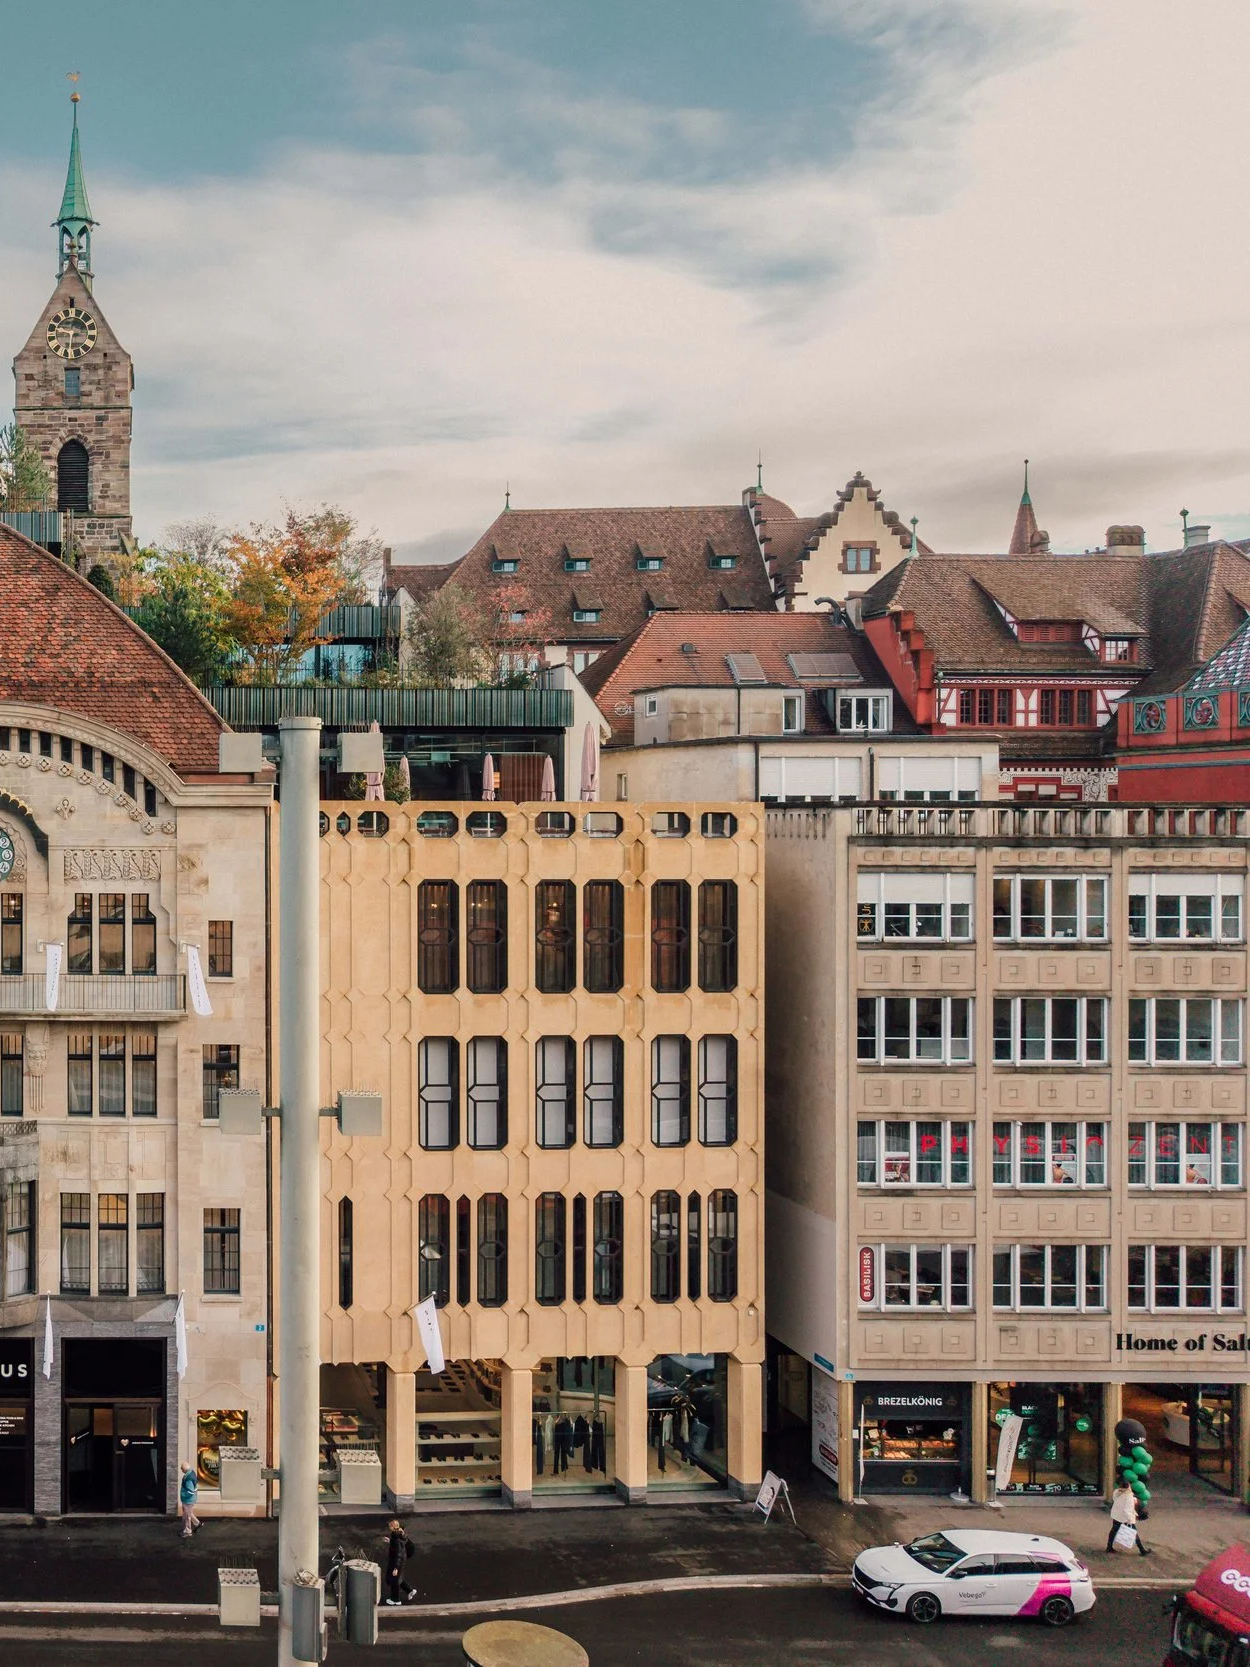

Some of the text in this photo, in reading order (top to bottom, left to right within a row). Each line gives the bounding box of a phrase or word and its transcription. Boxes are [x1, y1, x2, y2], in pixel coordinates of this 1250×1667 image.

[863, 1252, 871, 1298] BASILISK
[1116, 1333, 1178, 1351] Home
[1184, 1333, 1207, 1351] of
[877, 1395, 943, 1406] BREZELKÖNIG
[958, 1592, 984, 1600] Vebego
